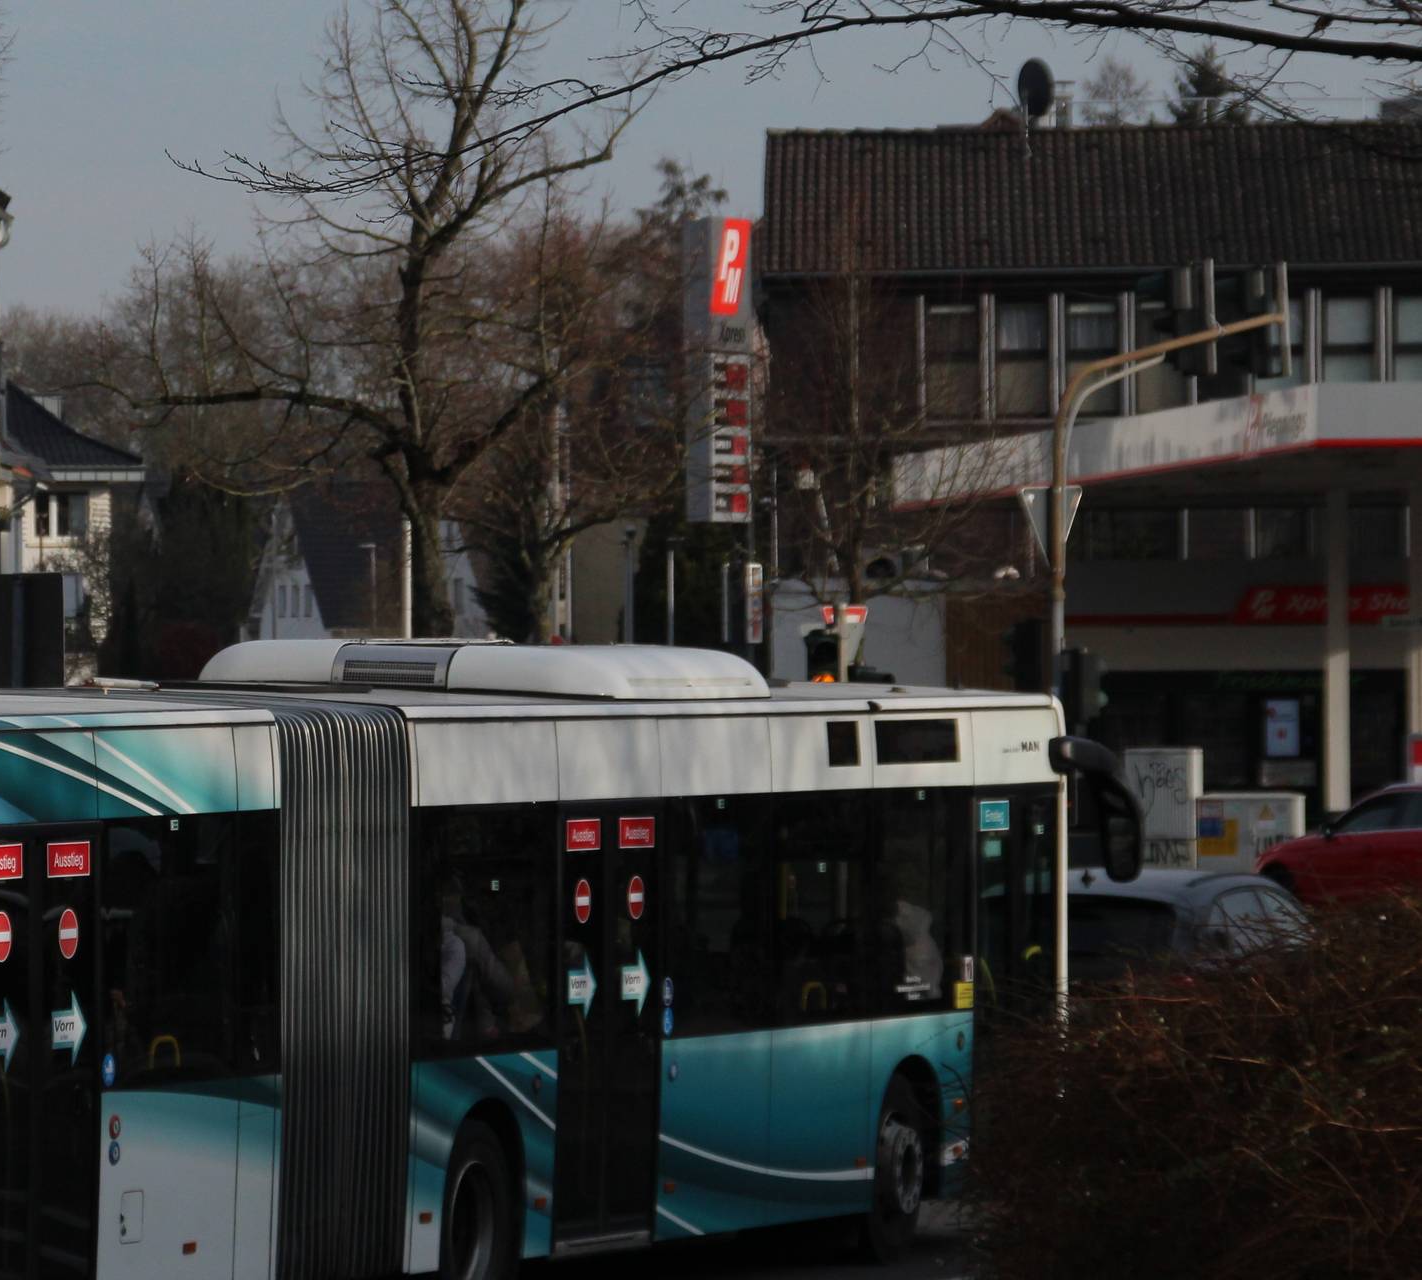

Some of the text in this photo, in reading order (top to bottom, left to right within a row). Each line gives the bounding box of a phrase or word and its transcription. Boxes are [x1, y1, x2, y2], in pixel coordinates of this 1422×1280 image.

[53, 851, 84, 870] Ausstieg
[571, 978, 588, 990] Vorn
[624, 974, 642, 986] Vorn
[54, 1020, 75, 1033] Vorn
